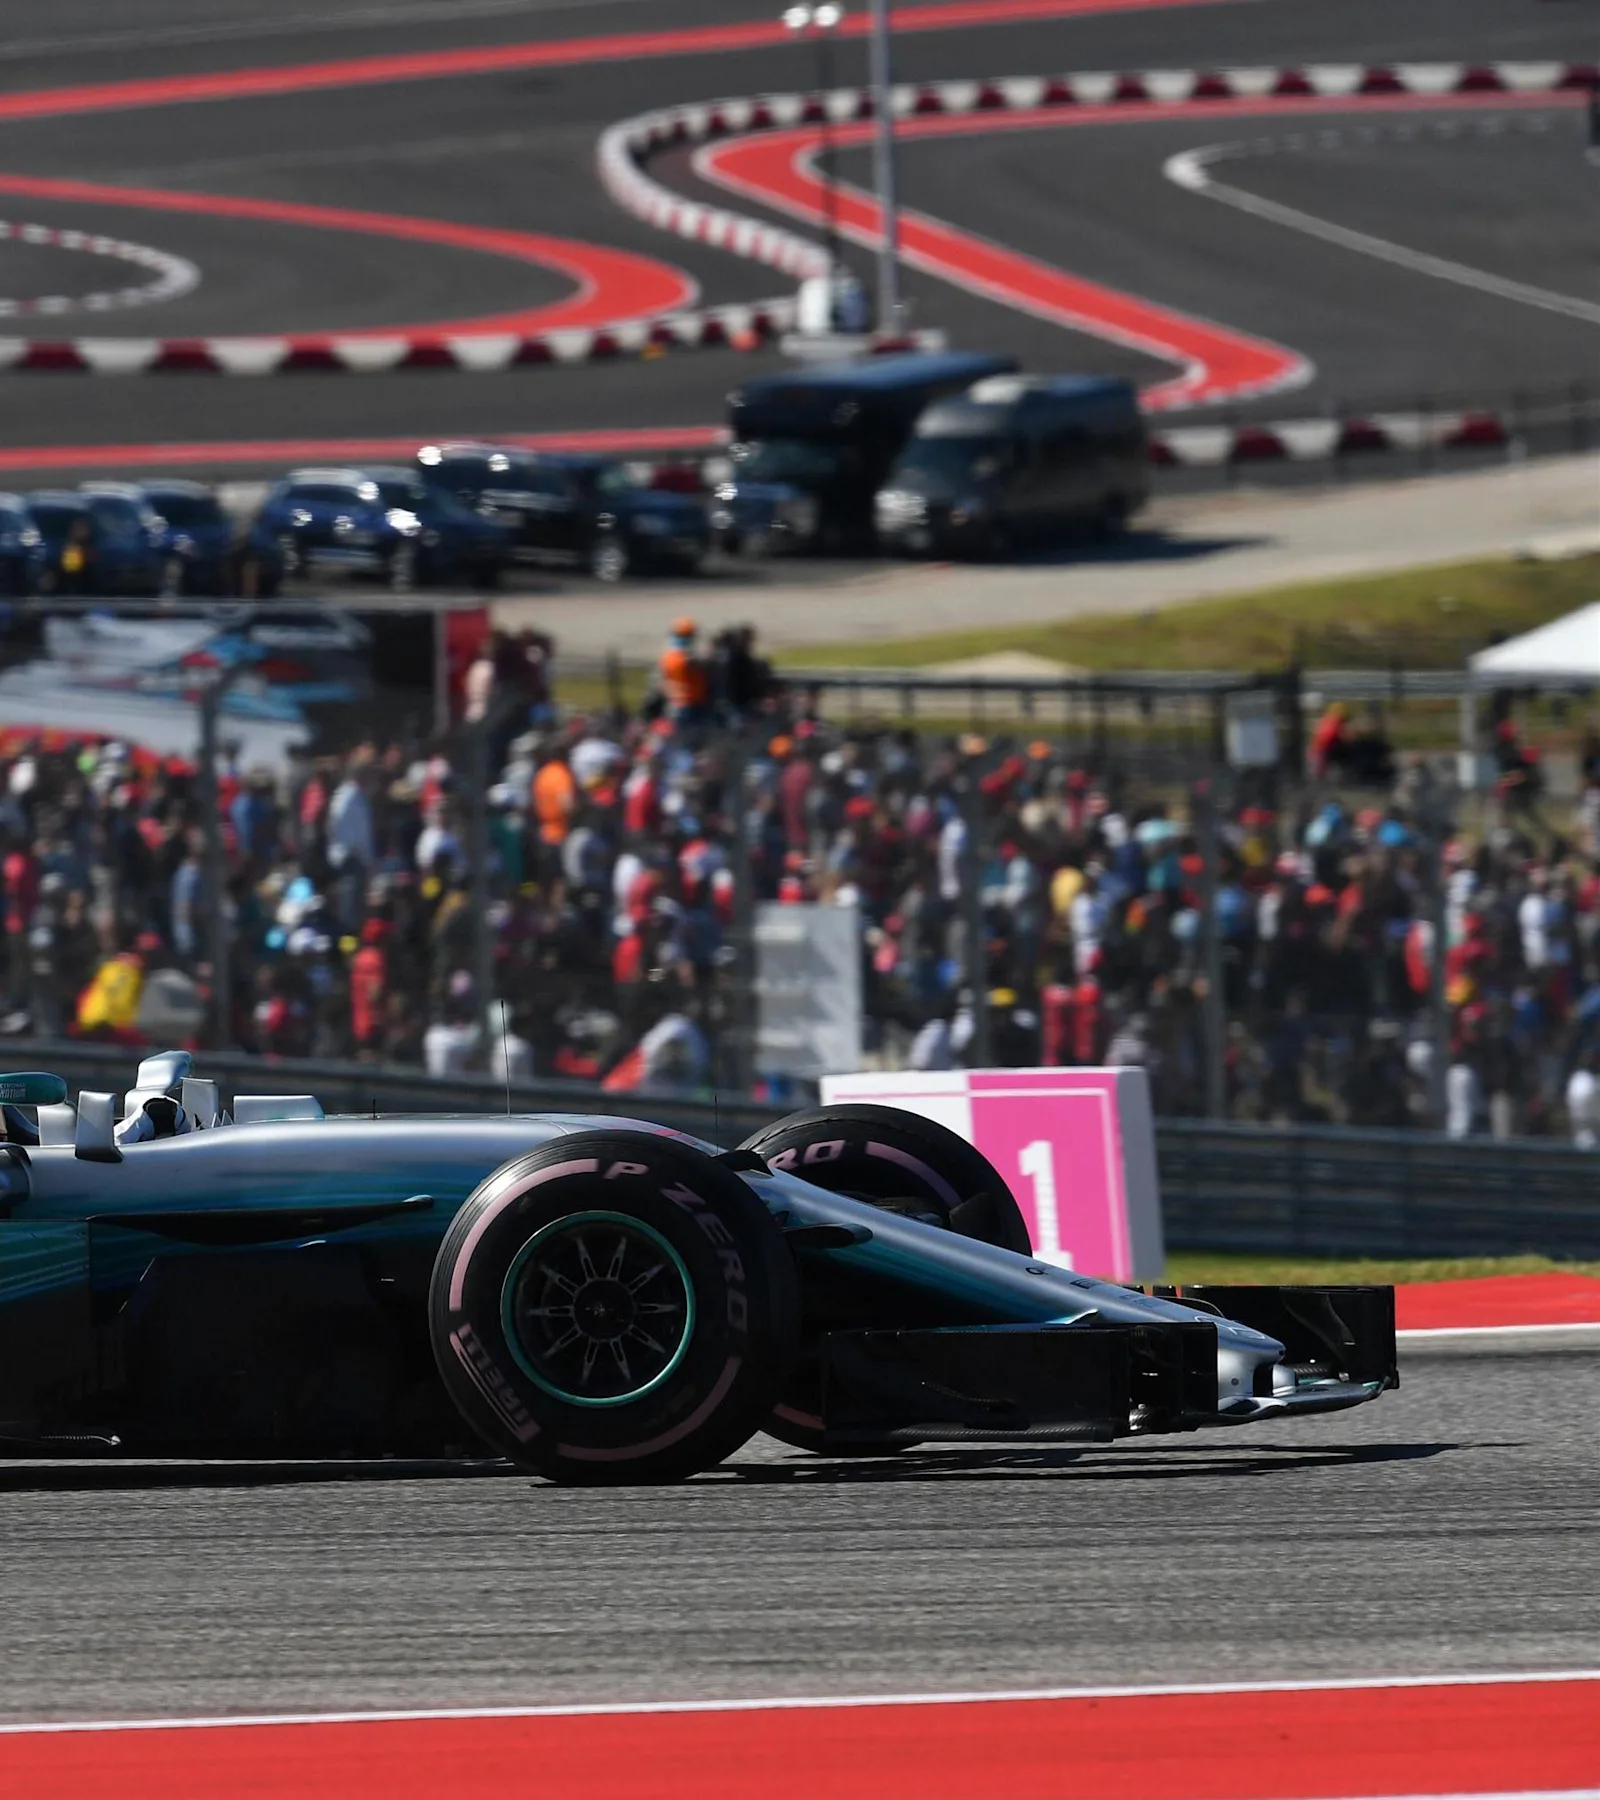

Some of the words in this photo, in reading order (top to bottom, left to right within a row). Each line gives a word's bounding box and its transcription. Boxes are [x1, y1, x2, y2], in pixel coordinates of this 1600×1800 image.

[604, 1160, 650, 1180] P
[660, 1181, 748, 1333] ZERO
[1018, 1140, 1075, 1271] 1
